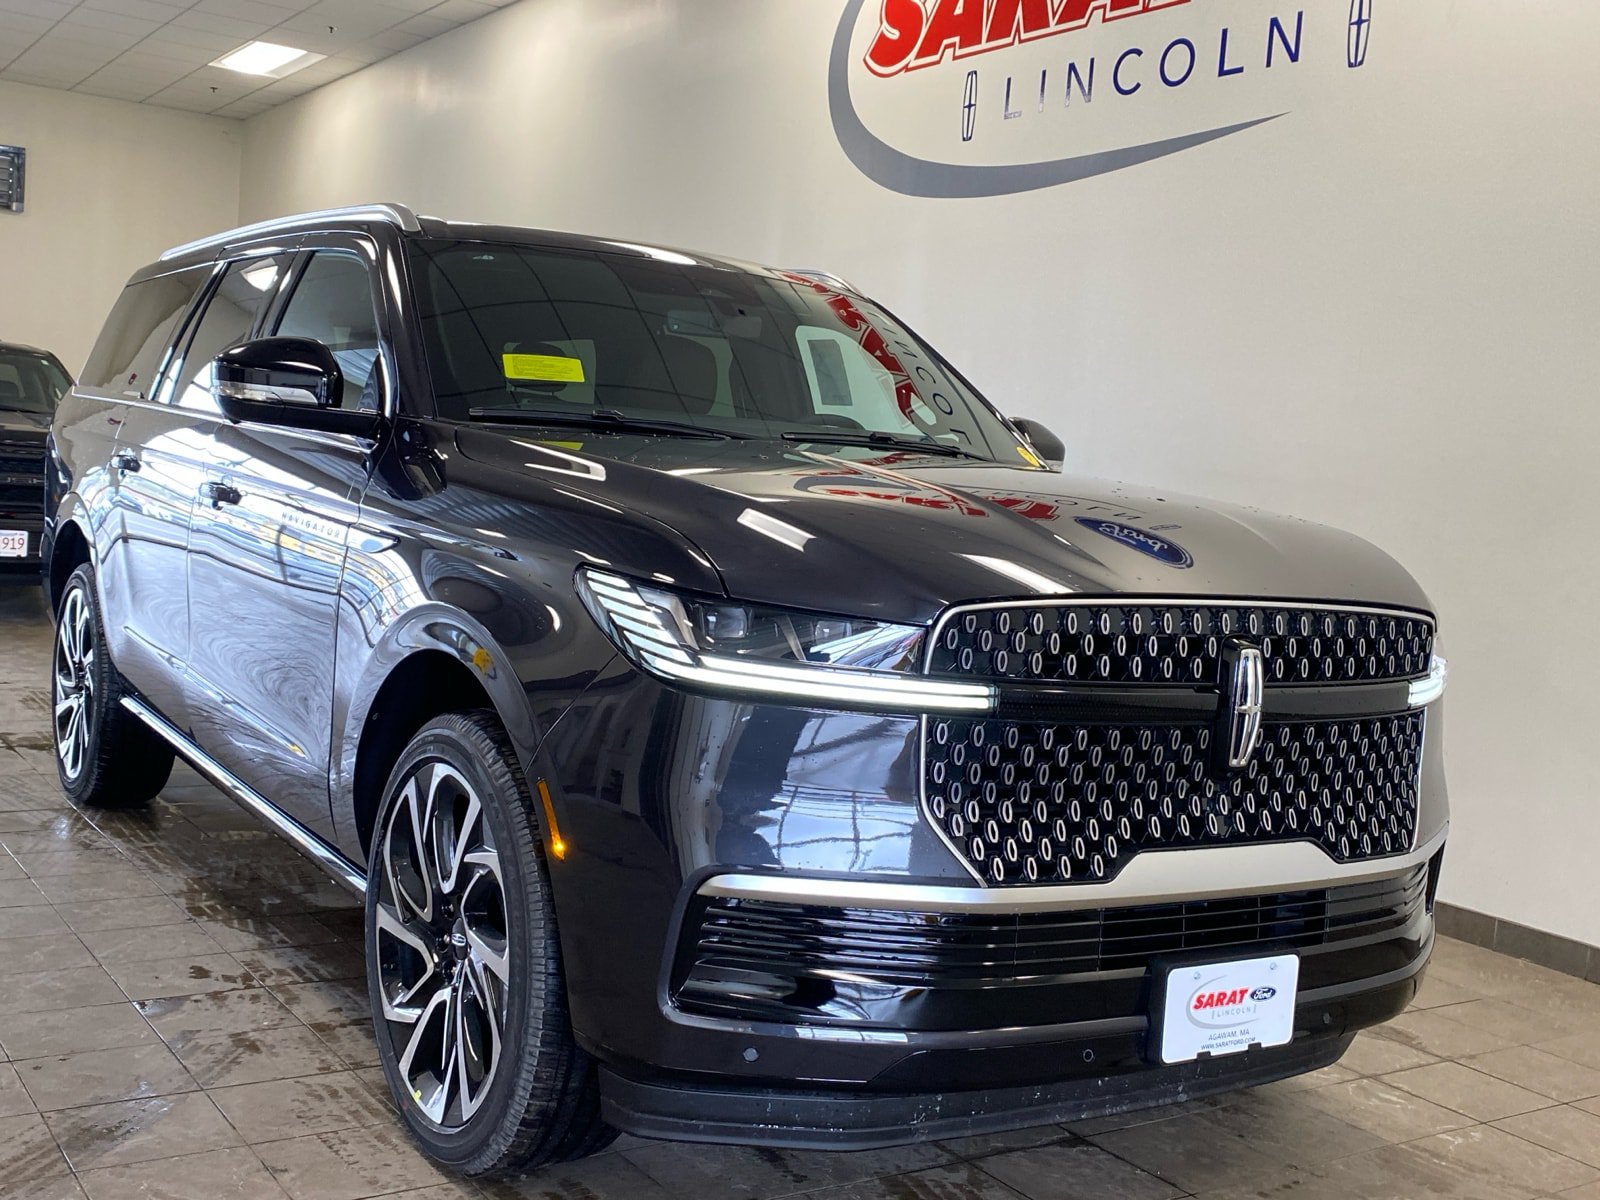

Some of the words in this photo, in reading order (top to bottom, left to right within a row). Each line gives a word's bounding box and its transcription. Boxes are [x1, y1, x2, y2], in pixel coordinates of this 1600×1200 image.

[1002, 10, 1304, 120] LINCOLN
[281, 511, 340, 538] NAVIGATOR
[2, 537, 25, 550] 919
[1193, 988, 1249, 1010] SARAT
[1252, 987, 1274, 1001] Ford
[1216, 1006, 1252, 1018] LINCOLN
[1239, 1028, 1250, 1037] MA
[1201, 1036, 1256, 1050] WWW.SARATFORD.COM
